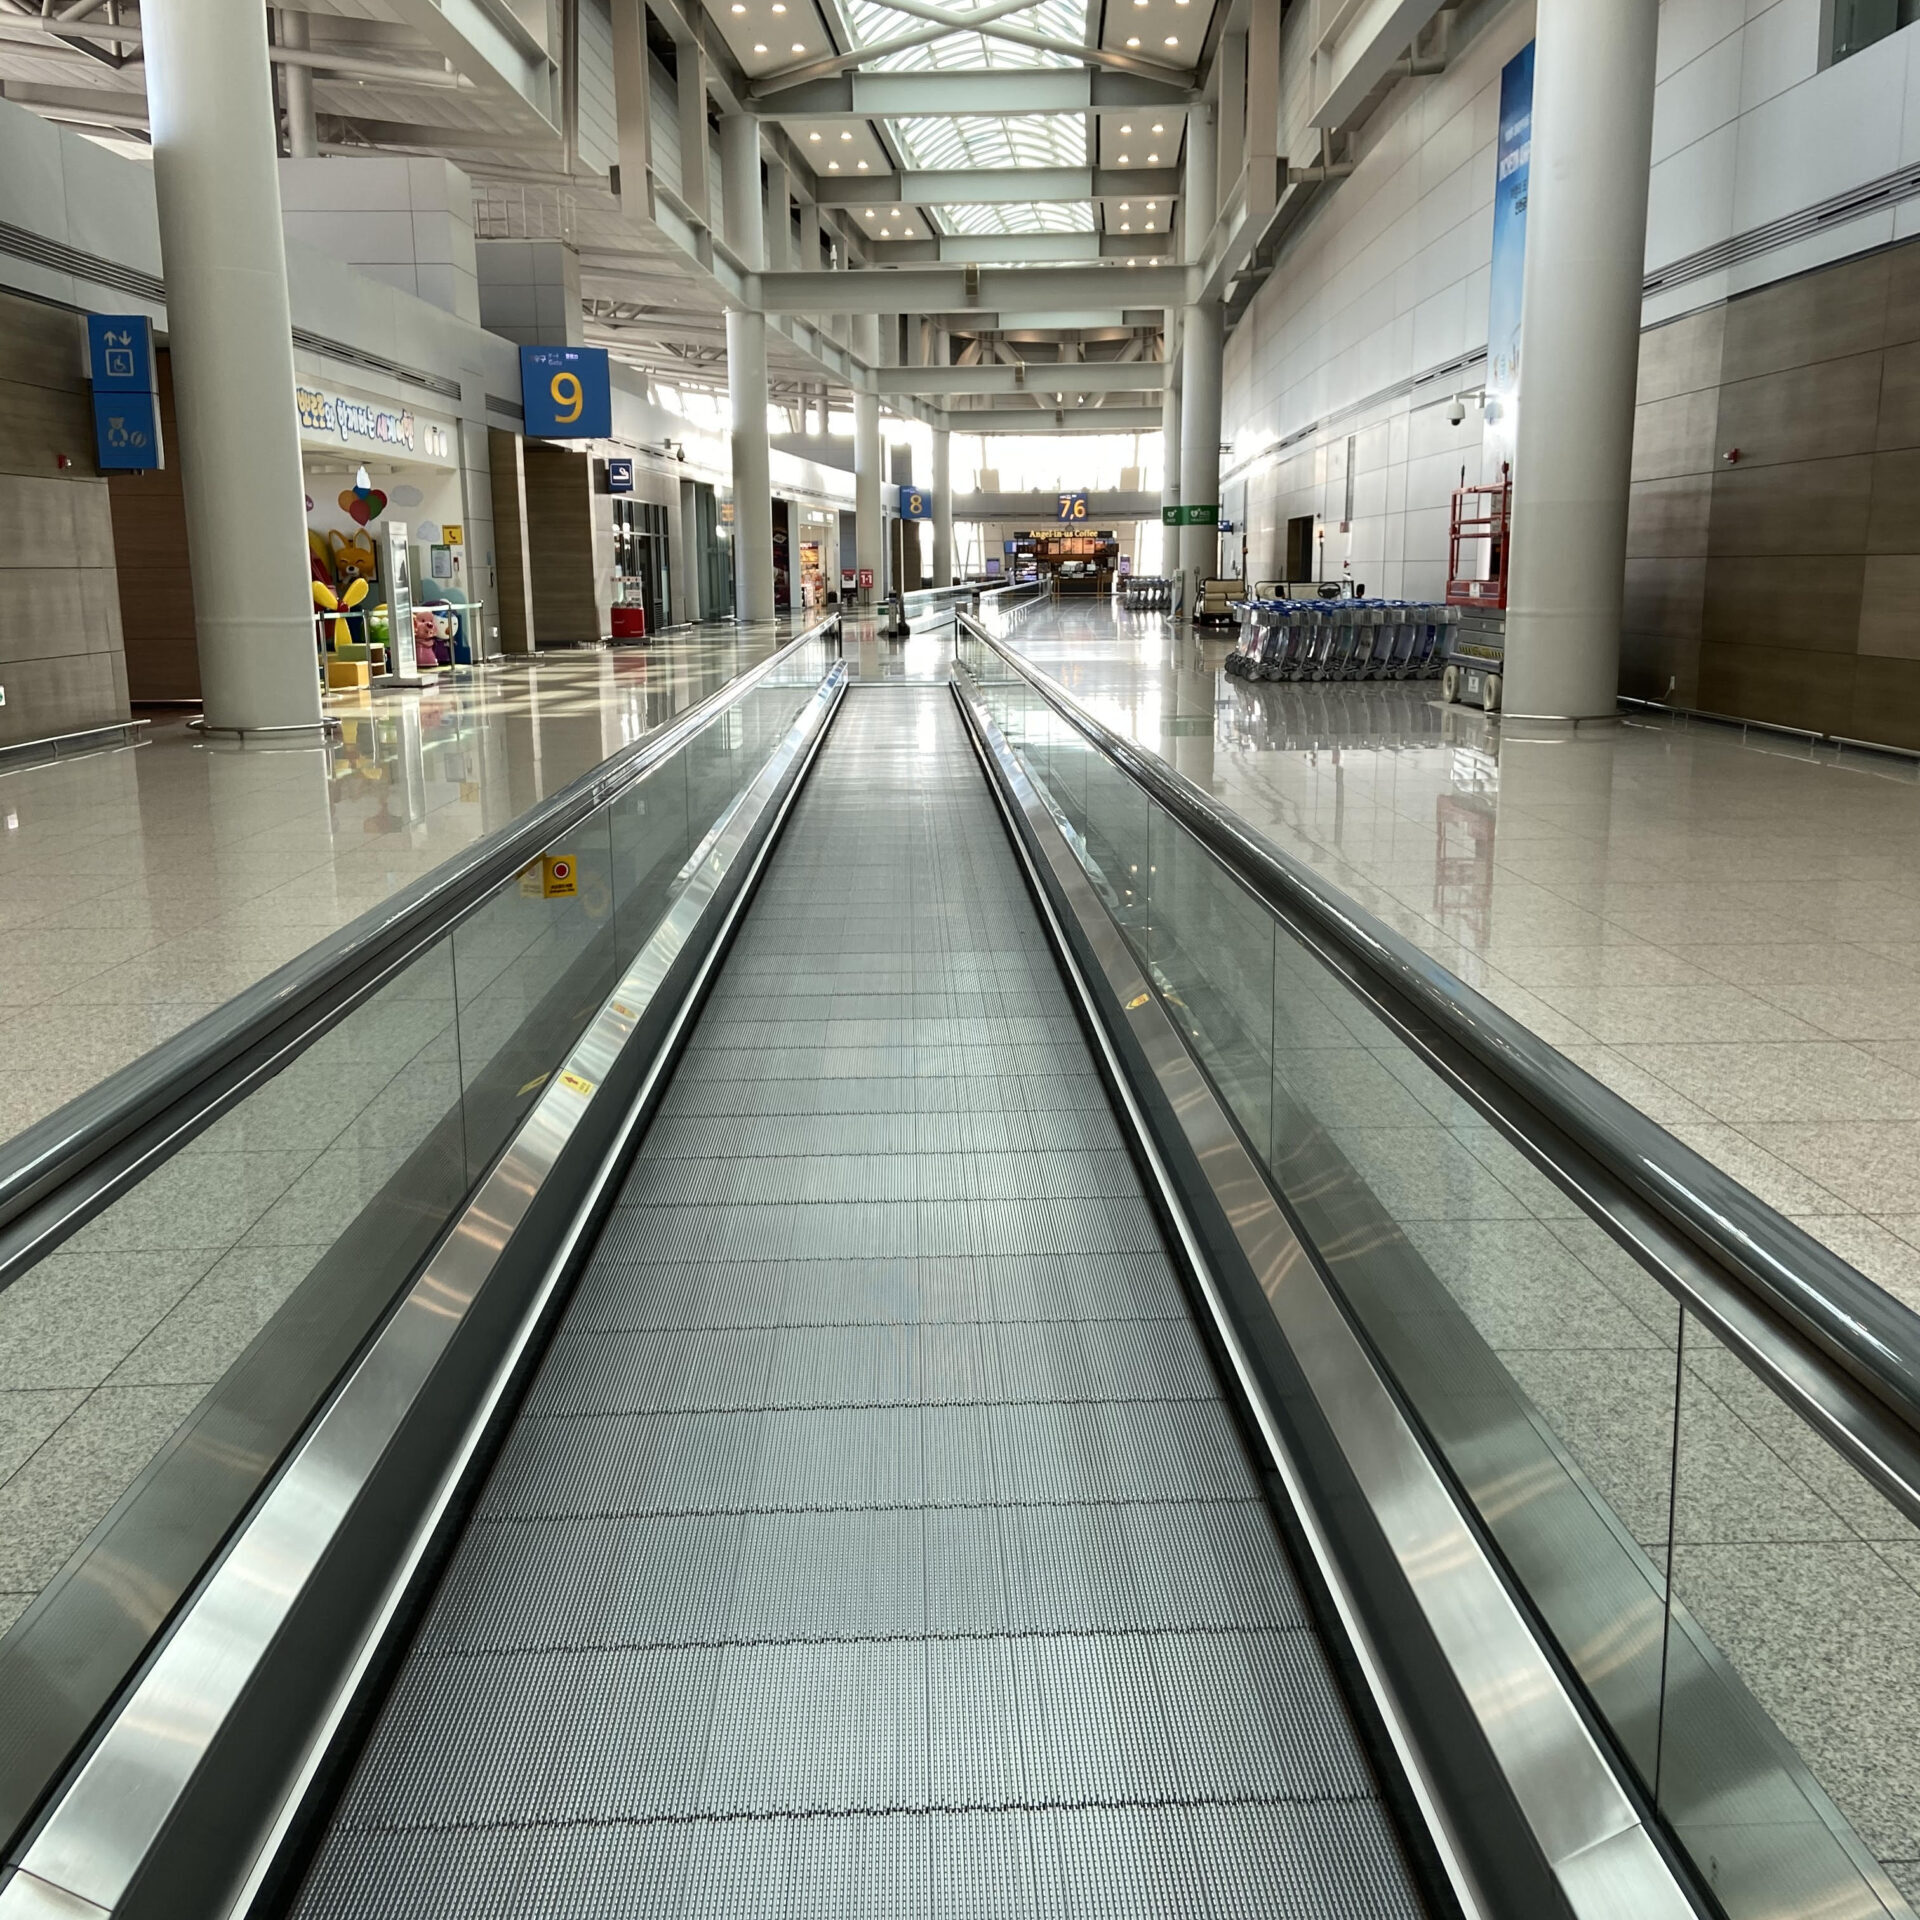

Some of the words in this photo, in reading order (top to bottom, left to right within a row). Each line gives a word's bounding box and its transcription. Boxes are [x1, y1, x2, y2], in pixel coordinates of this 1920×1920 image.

[551, 372, 583, 423] 9
[910, 494, 923, 514] 8
[1059, 499, 1087, 520] 7,6
[1074, 529, 1099, 538] Coffee
